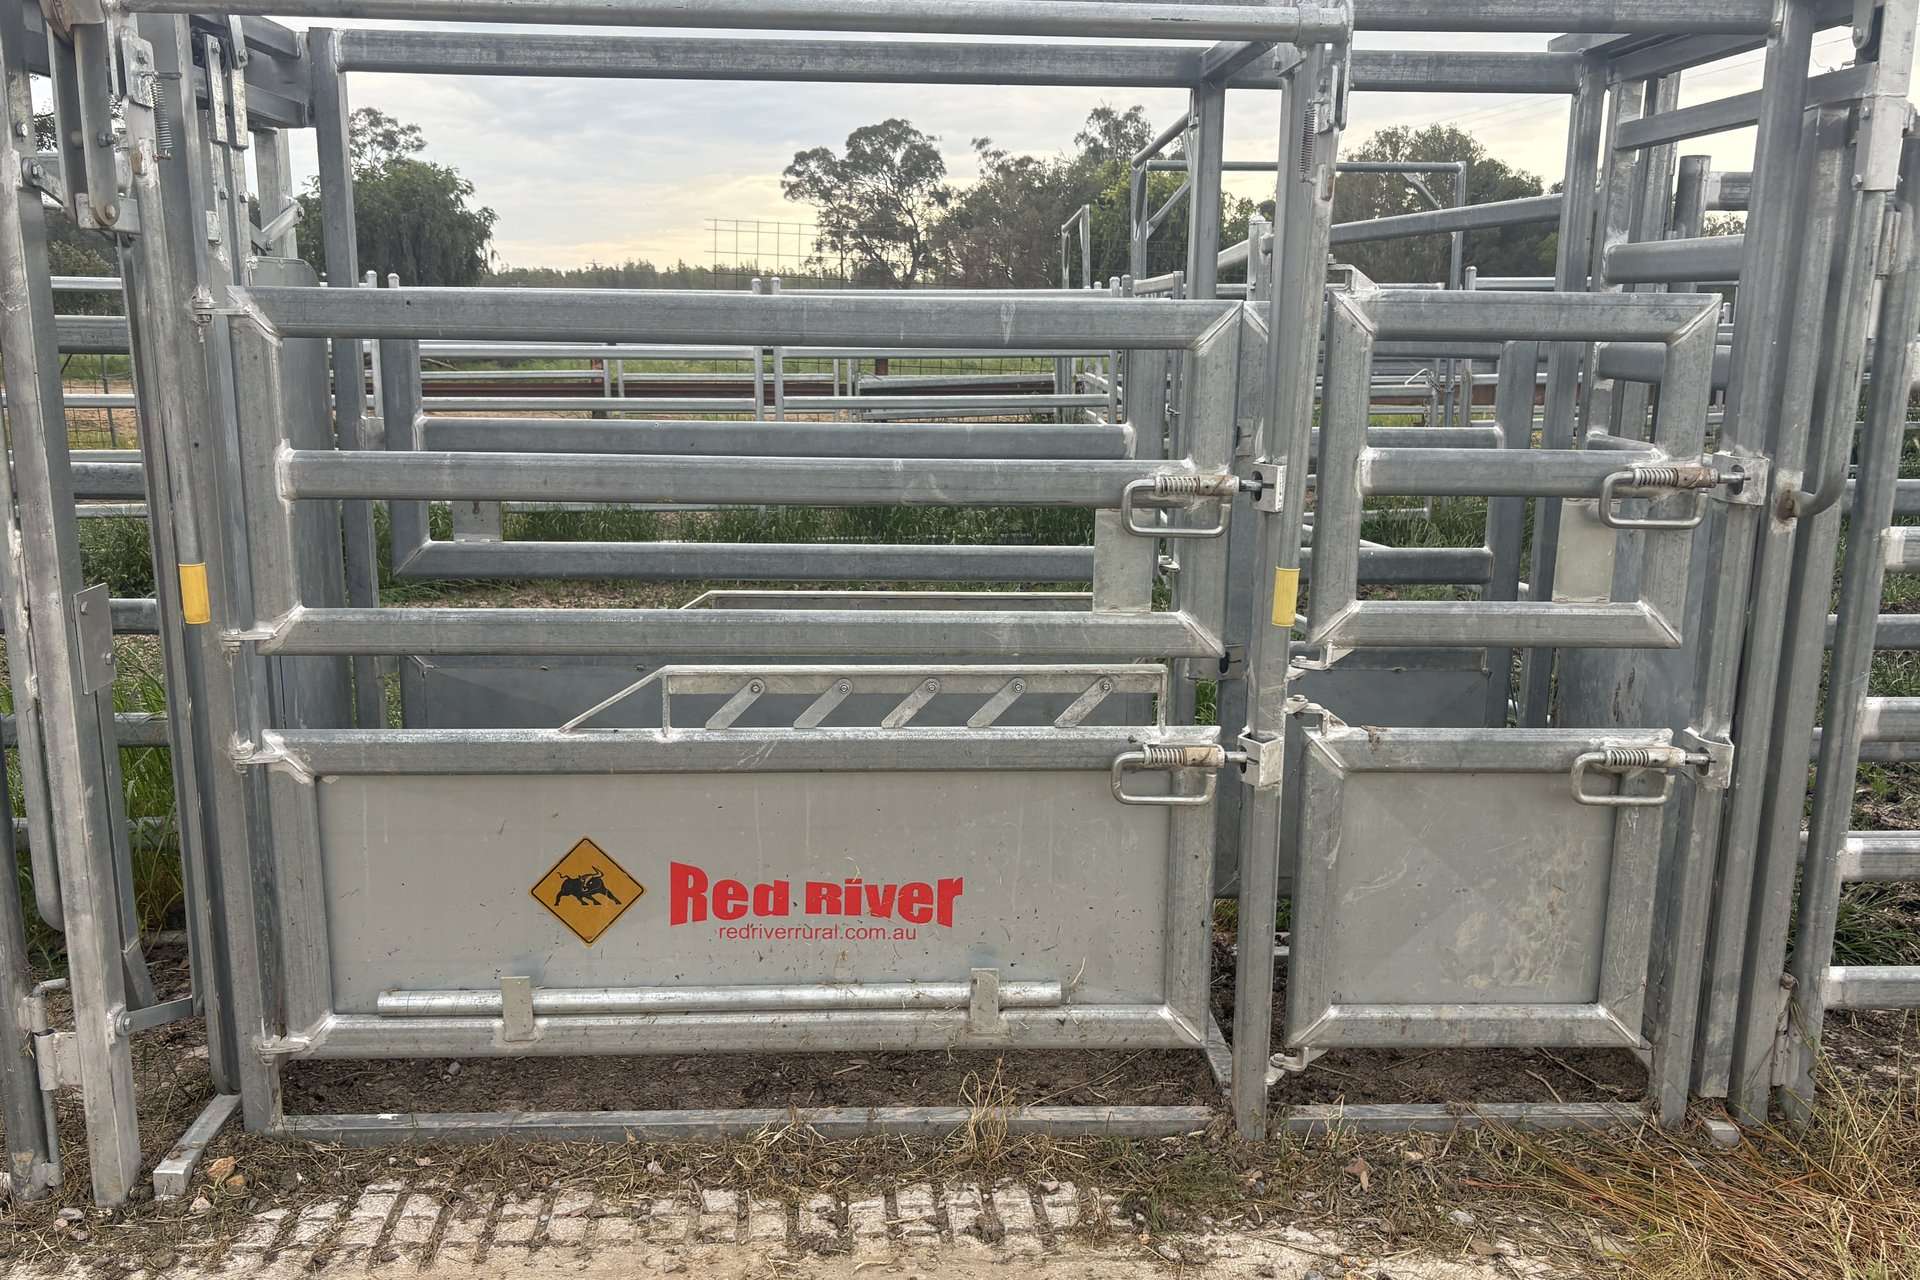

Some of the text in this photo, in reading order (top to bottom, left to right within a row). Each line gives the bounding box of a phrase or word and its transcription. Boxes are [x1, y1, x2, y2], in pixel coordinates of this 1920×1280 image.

[669, 860, 964, 928] Red River
[718, 923, 918, 942] redriverrural.com.au
